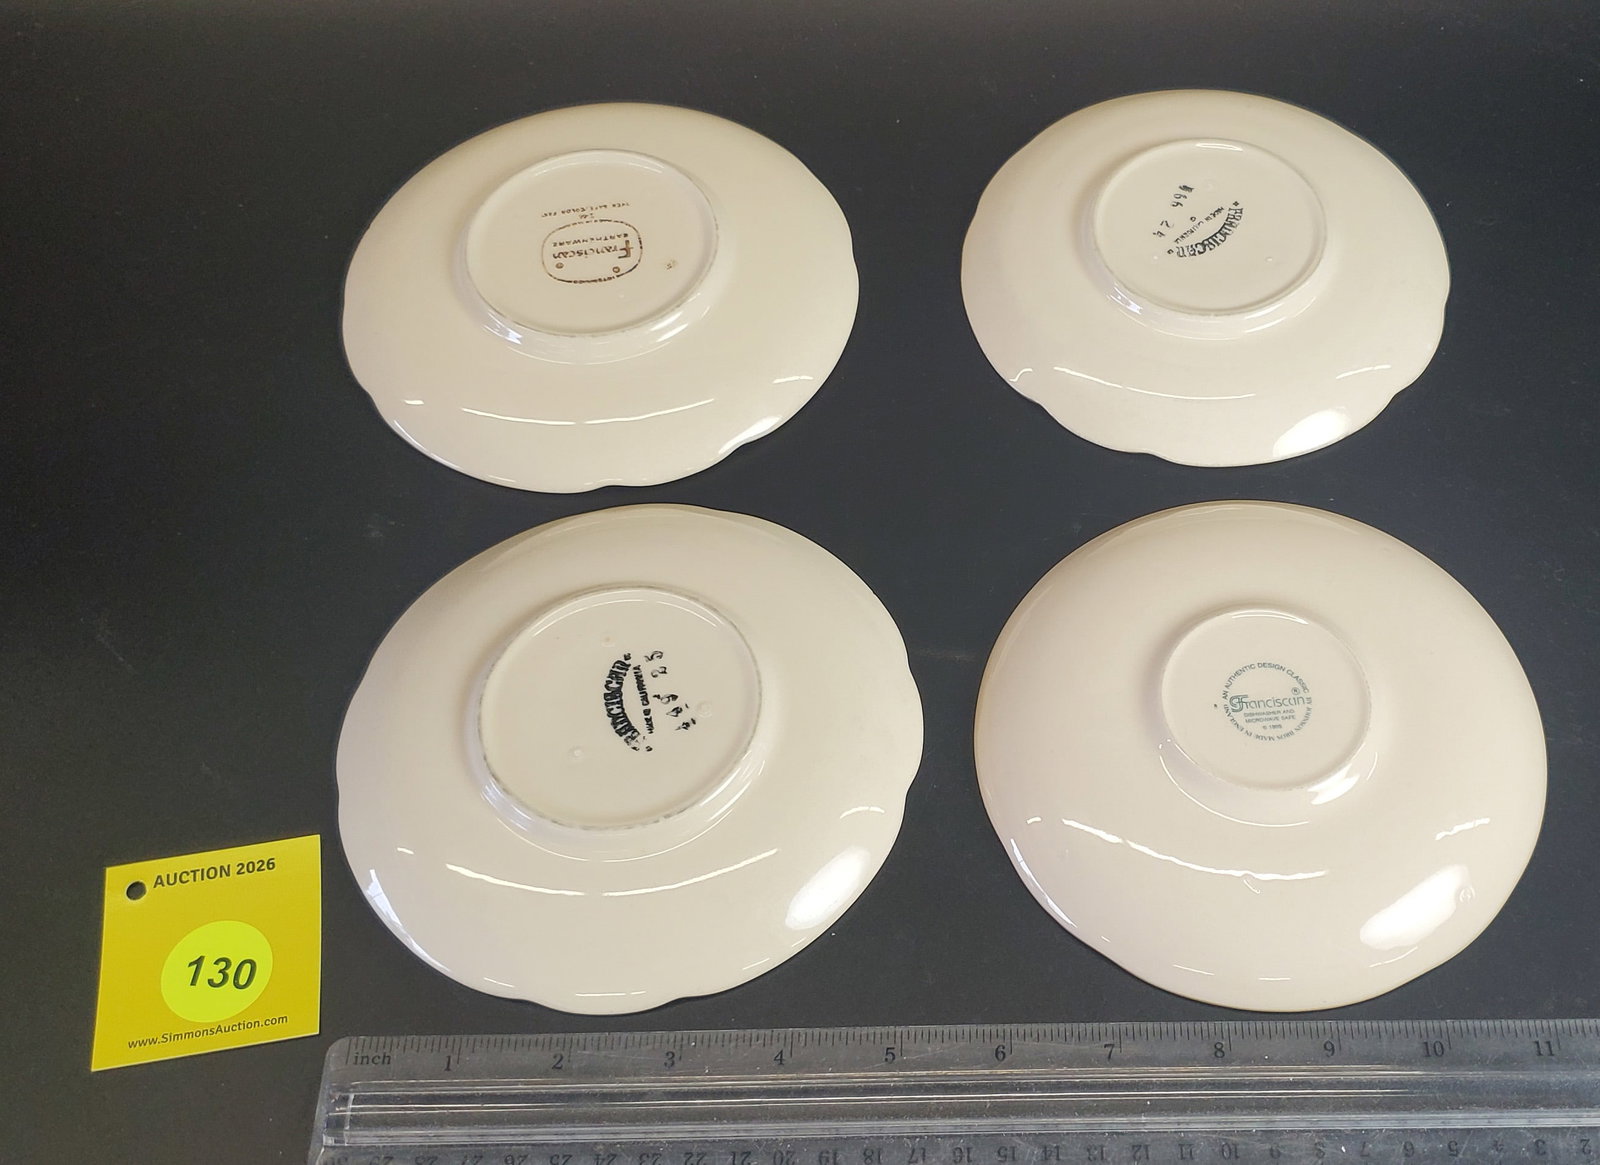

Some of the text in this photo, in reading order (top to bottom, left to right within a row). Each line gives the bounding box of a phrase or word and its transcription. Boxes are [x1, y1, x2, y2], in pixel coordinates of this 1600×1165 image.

[1224, 663, 1256, 689] AUTHENTIC
[1257, 662, 1286, 672] DESIGN
[1286, 669, 1310, 694] CLASSIC
[153, 857, 276, 888] AUCTION 2026
[187, 955, 257, 990] 130
[128, 1014, 288, 1049] www.SimmonsAuction.com
[353, 1040, 1555, 1072] inch 1 2 3 4 5 6 7 8 9 10 11
